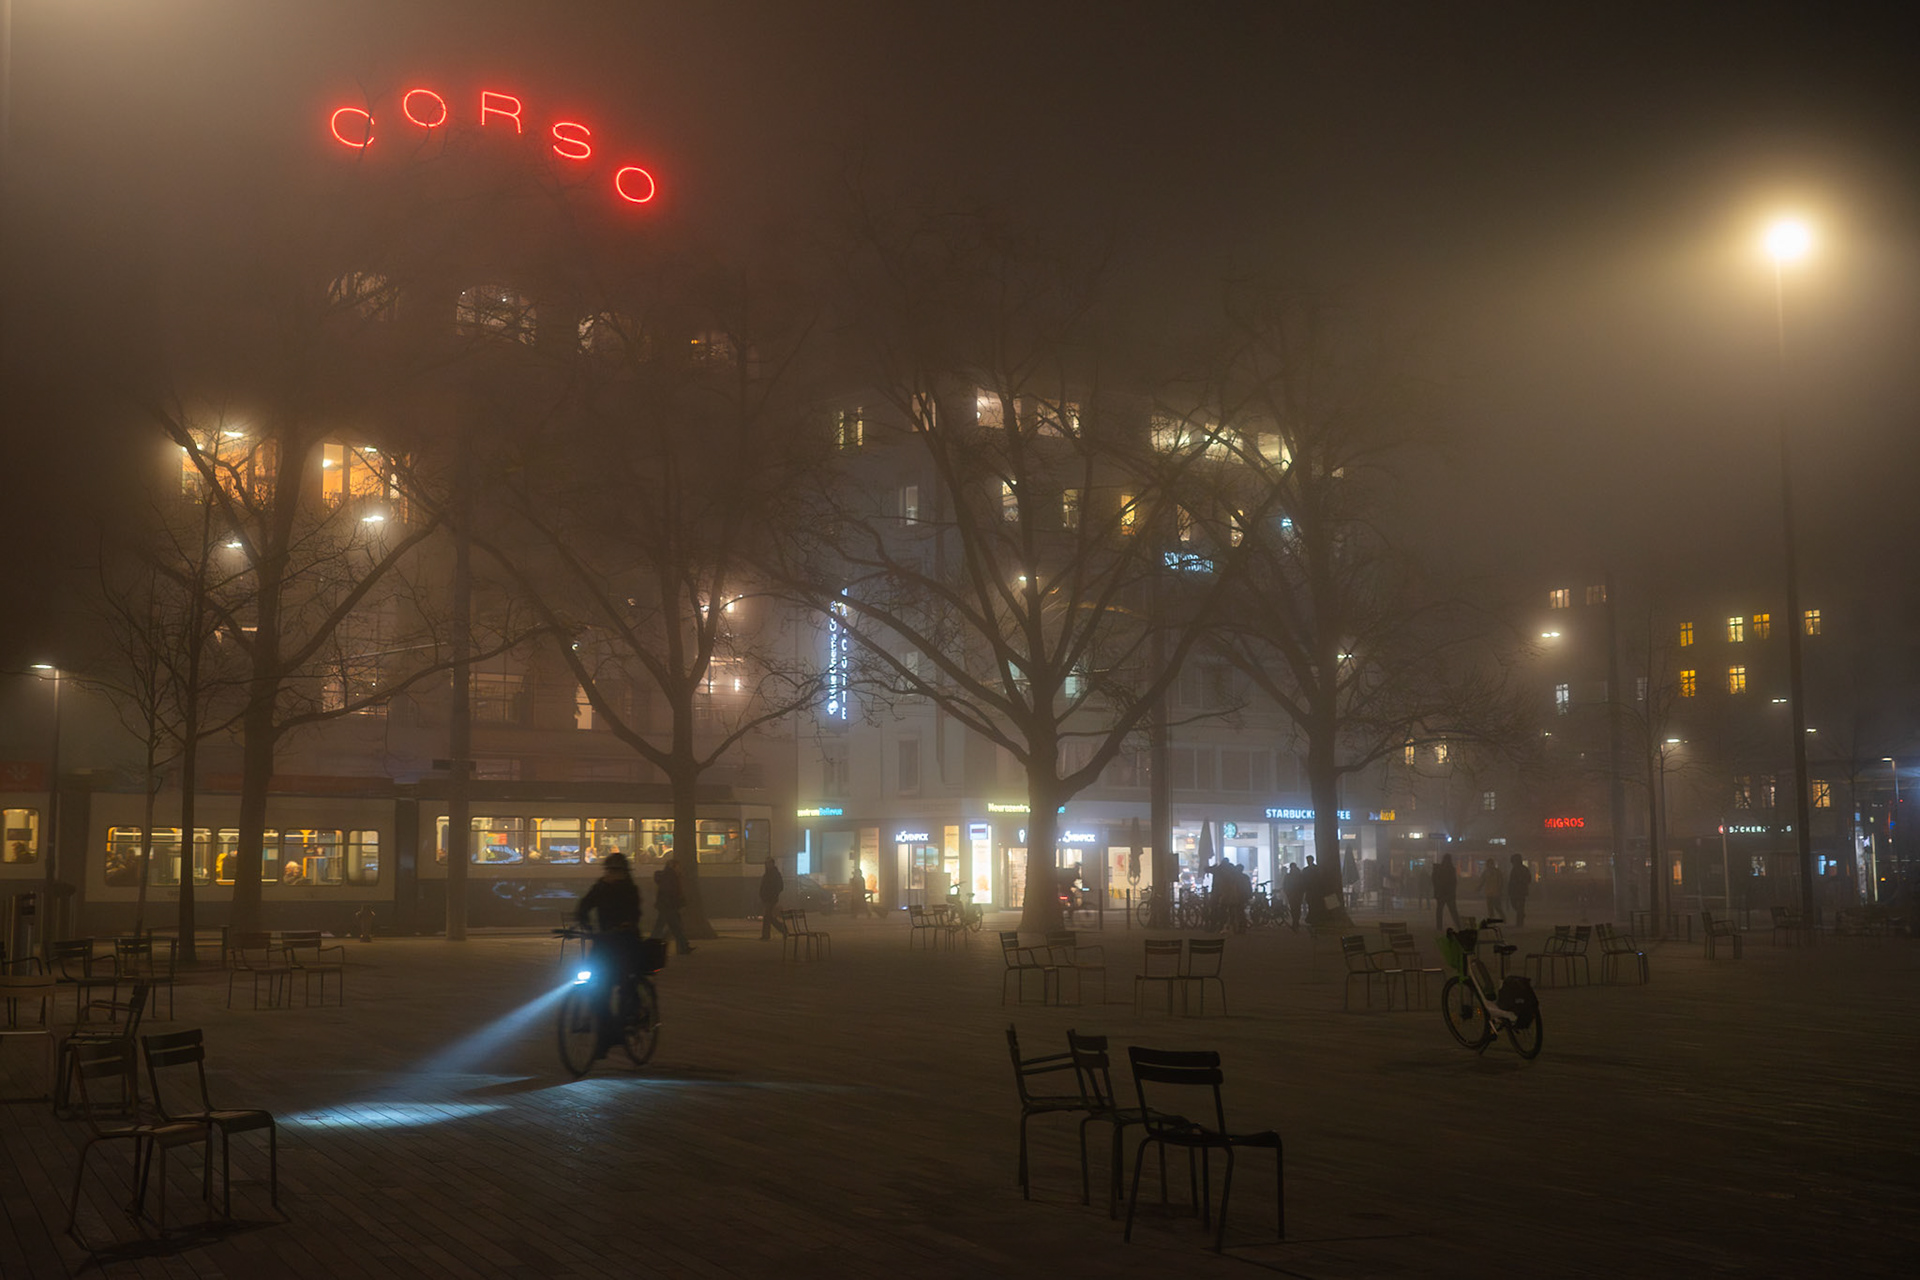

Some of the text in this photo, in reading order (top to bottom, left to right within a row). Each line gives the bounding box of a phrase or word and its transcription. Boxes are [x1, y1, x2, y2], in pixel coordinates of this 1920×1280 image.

[330, 88, 656, 204] CORSO
[1544, 817, 1585, 829] MIGROS
[1058, 830, 1096, 843] ÖVENPICK
